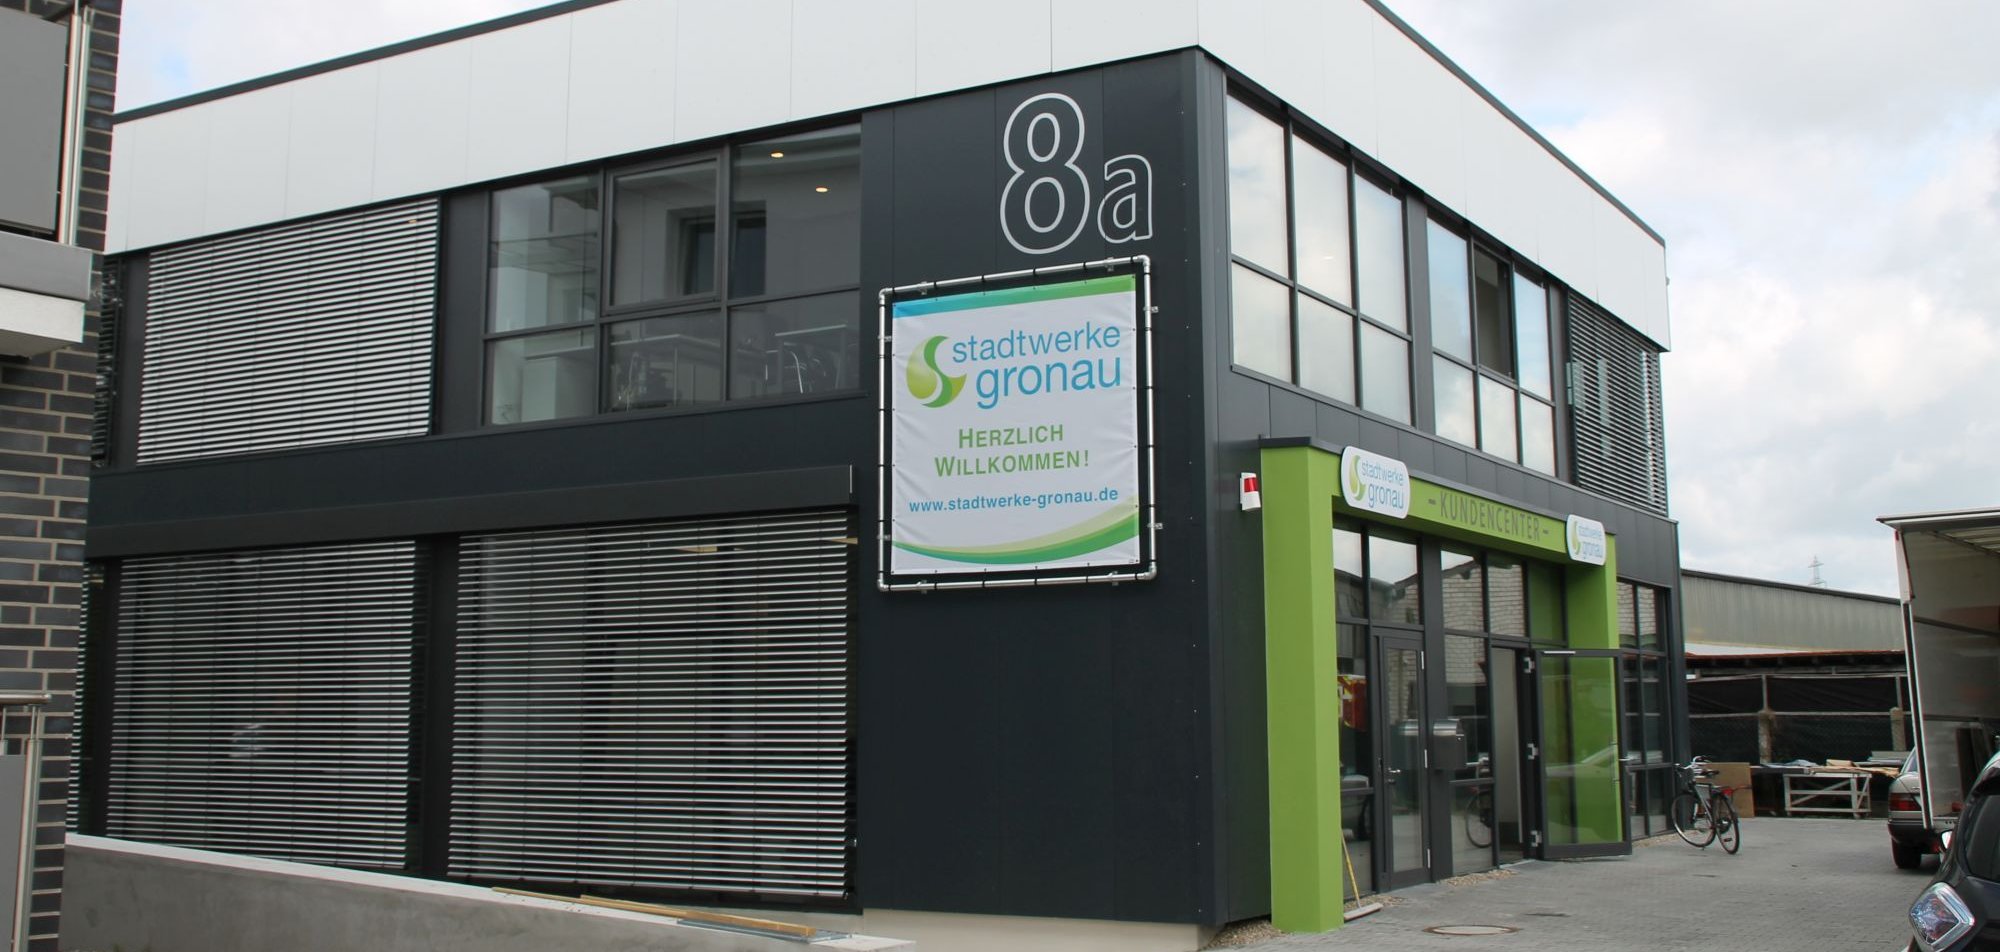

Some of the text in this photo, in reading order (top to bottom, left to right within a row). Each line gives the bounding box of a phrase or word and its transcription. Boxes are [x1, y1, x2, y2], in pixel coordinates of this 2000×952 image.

[1000, 92, 1153, 254] 8a
[952, 321, 1121, 363] stadtwerke
[975, 356, 1121, 410] gronau
[958, 424, 1064, 449] HERZLICH
[934, 449, 1089, 477] WILLKOMMEN!
[1361, 459, 1404, 486] stadtwerke
[909, 487, 1119, 512] www.stadtwerke-gronau.de
[1367, 482, 1404, 510] gronau
